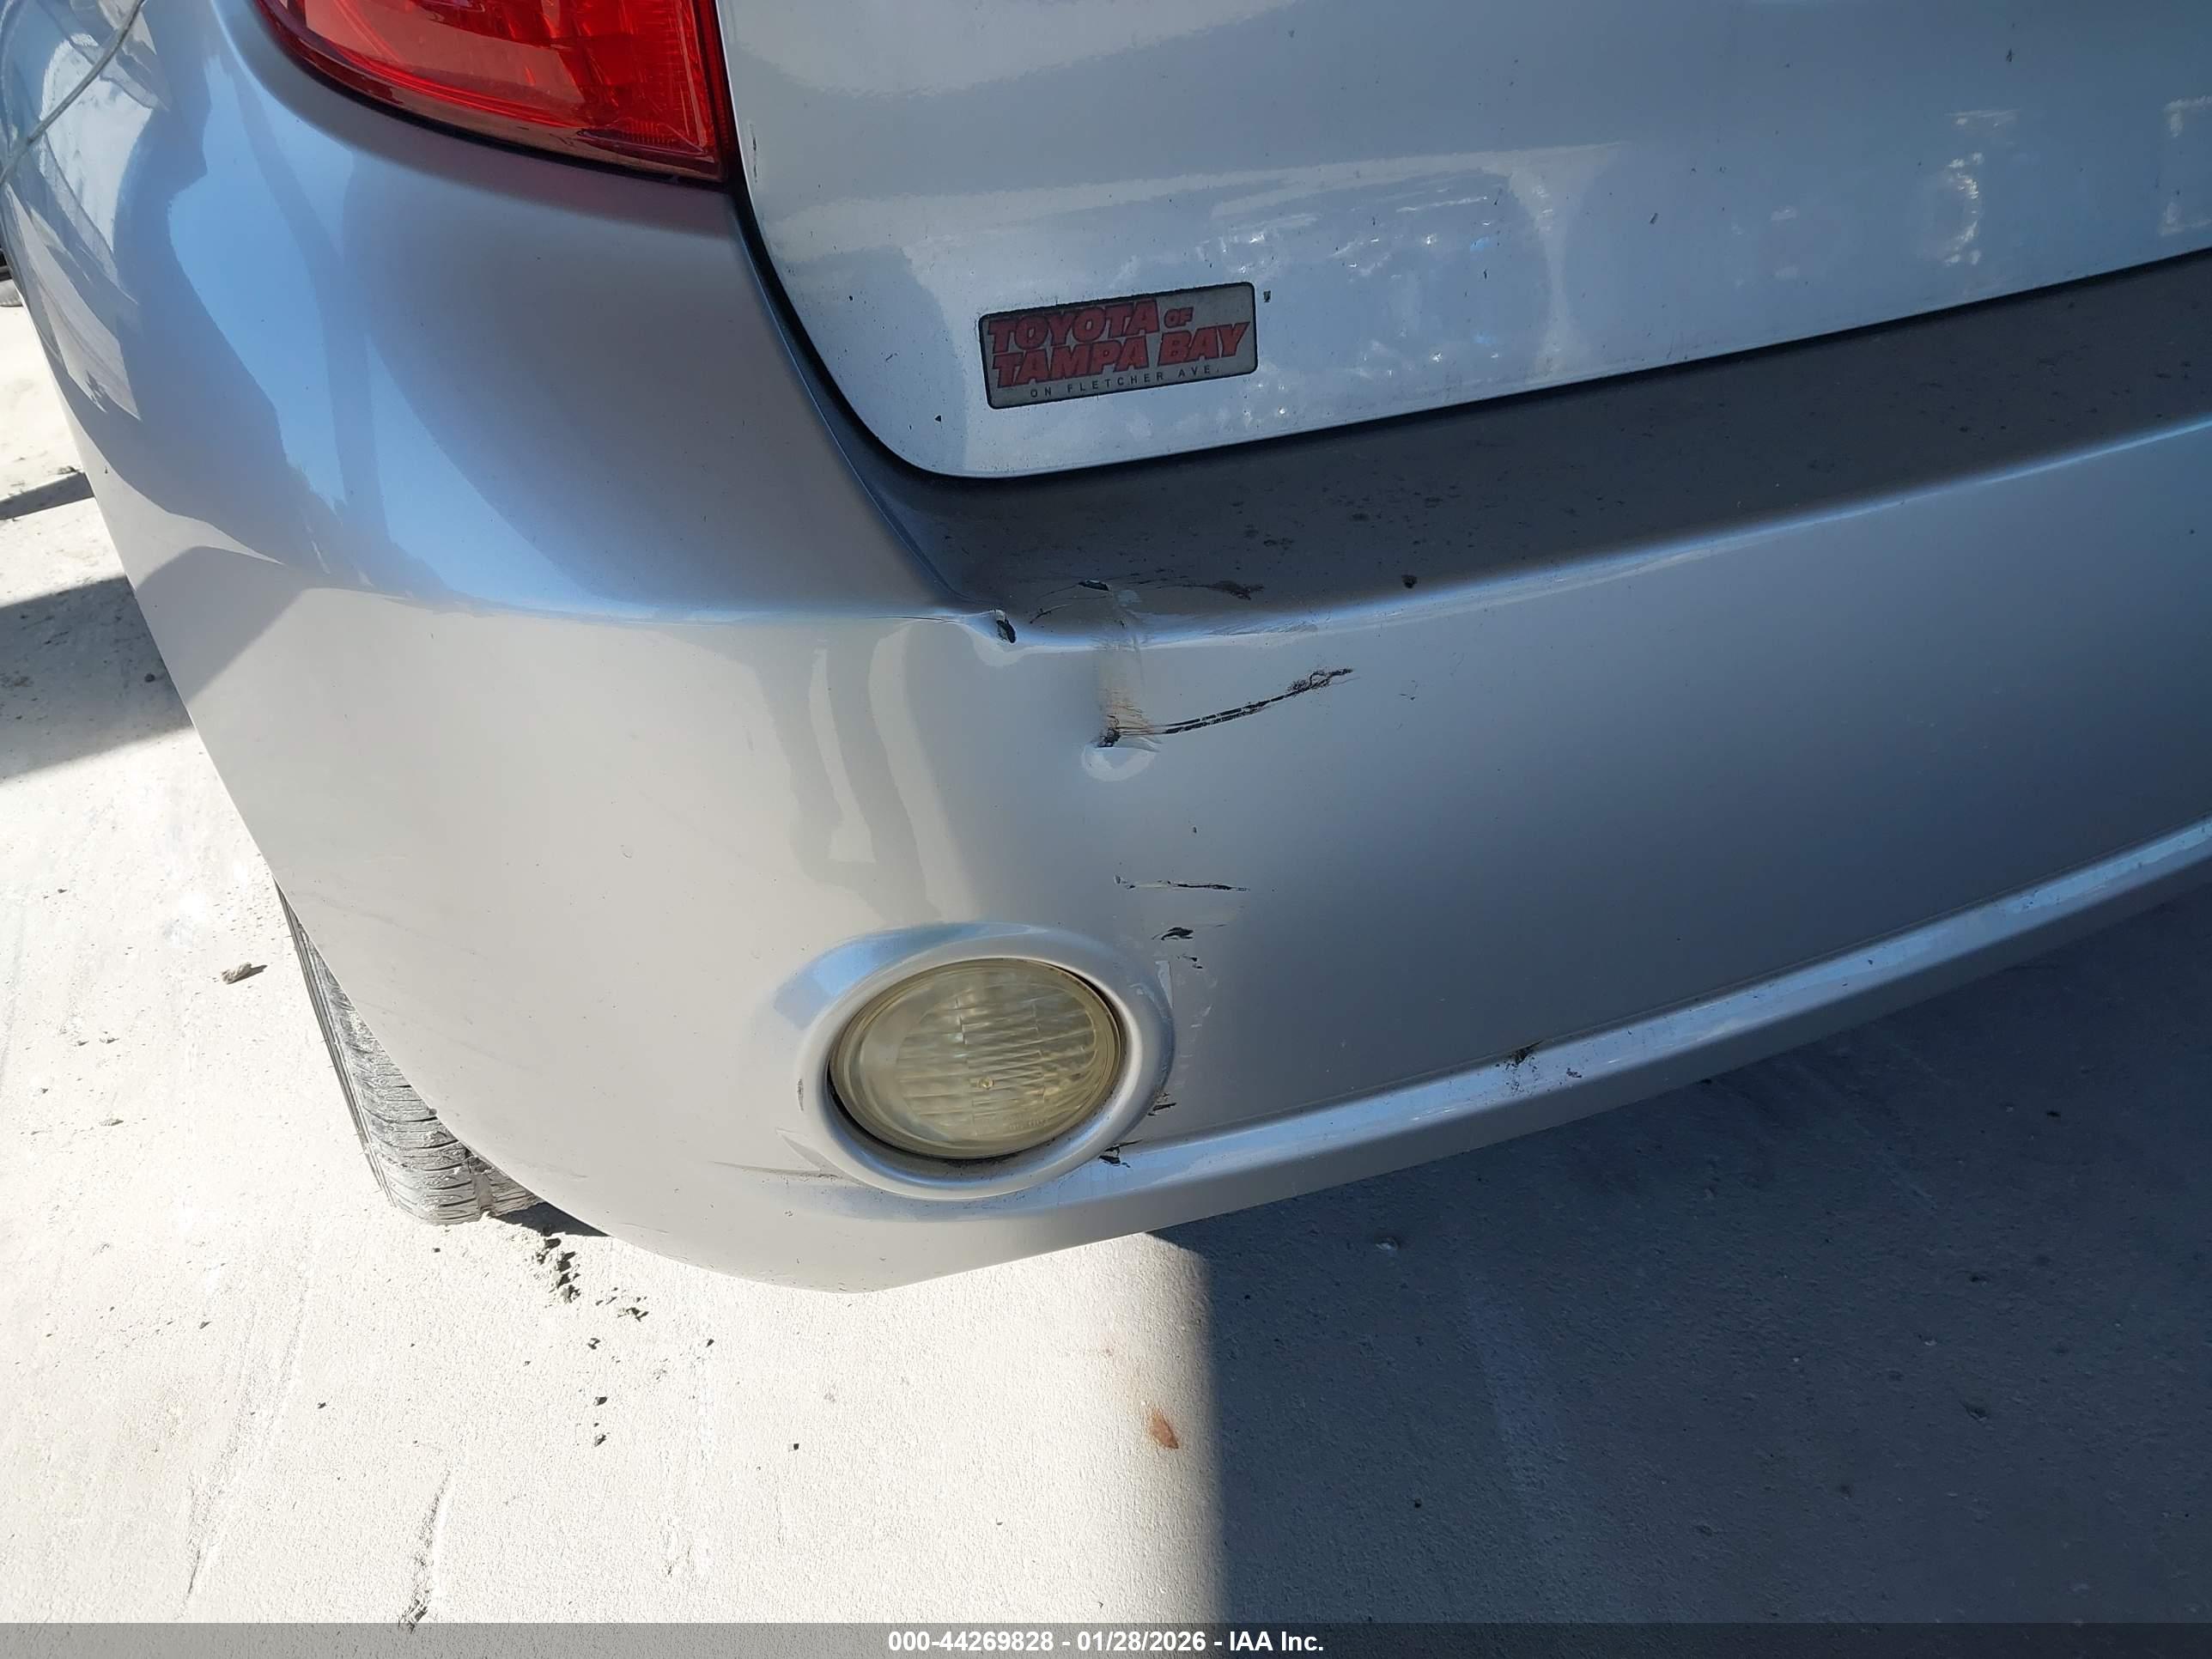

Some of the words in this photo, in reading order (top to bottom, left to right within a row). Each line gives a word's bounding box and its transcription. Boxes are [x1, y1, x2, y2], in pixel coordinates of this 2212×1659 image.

[988, 300, 1160, 354] TOYOTA
[1164, 307, 1194, 329] OF
[992, 336, 1149, 389] TAMPA
[1158, 321, 1250, 367] BAY
[1030, 386, 1052, 398] ON
[1067, 372, 1164, 392] FLETCHER
